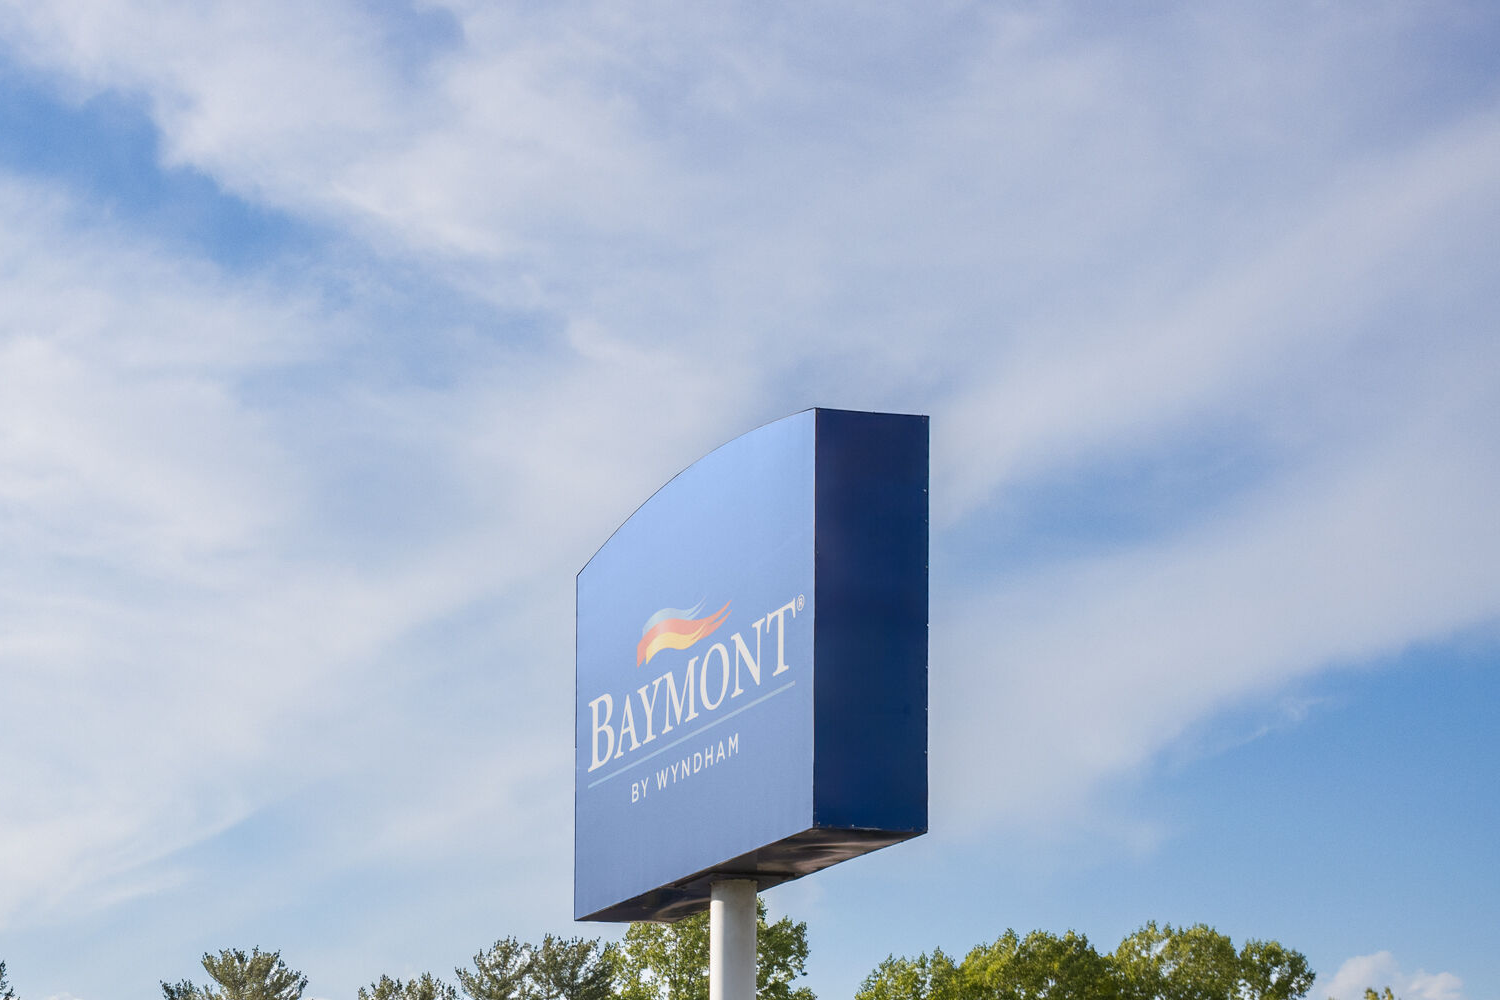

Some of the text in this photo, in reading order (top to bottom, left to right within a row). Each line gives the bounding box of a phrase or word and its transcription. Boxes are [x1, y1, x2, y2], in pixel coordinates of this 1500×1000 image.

[587, 598, 797, 773] BAYMONT
[631, 732, 740, 804] BY WYNDHAM
